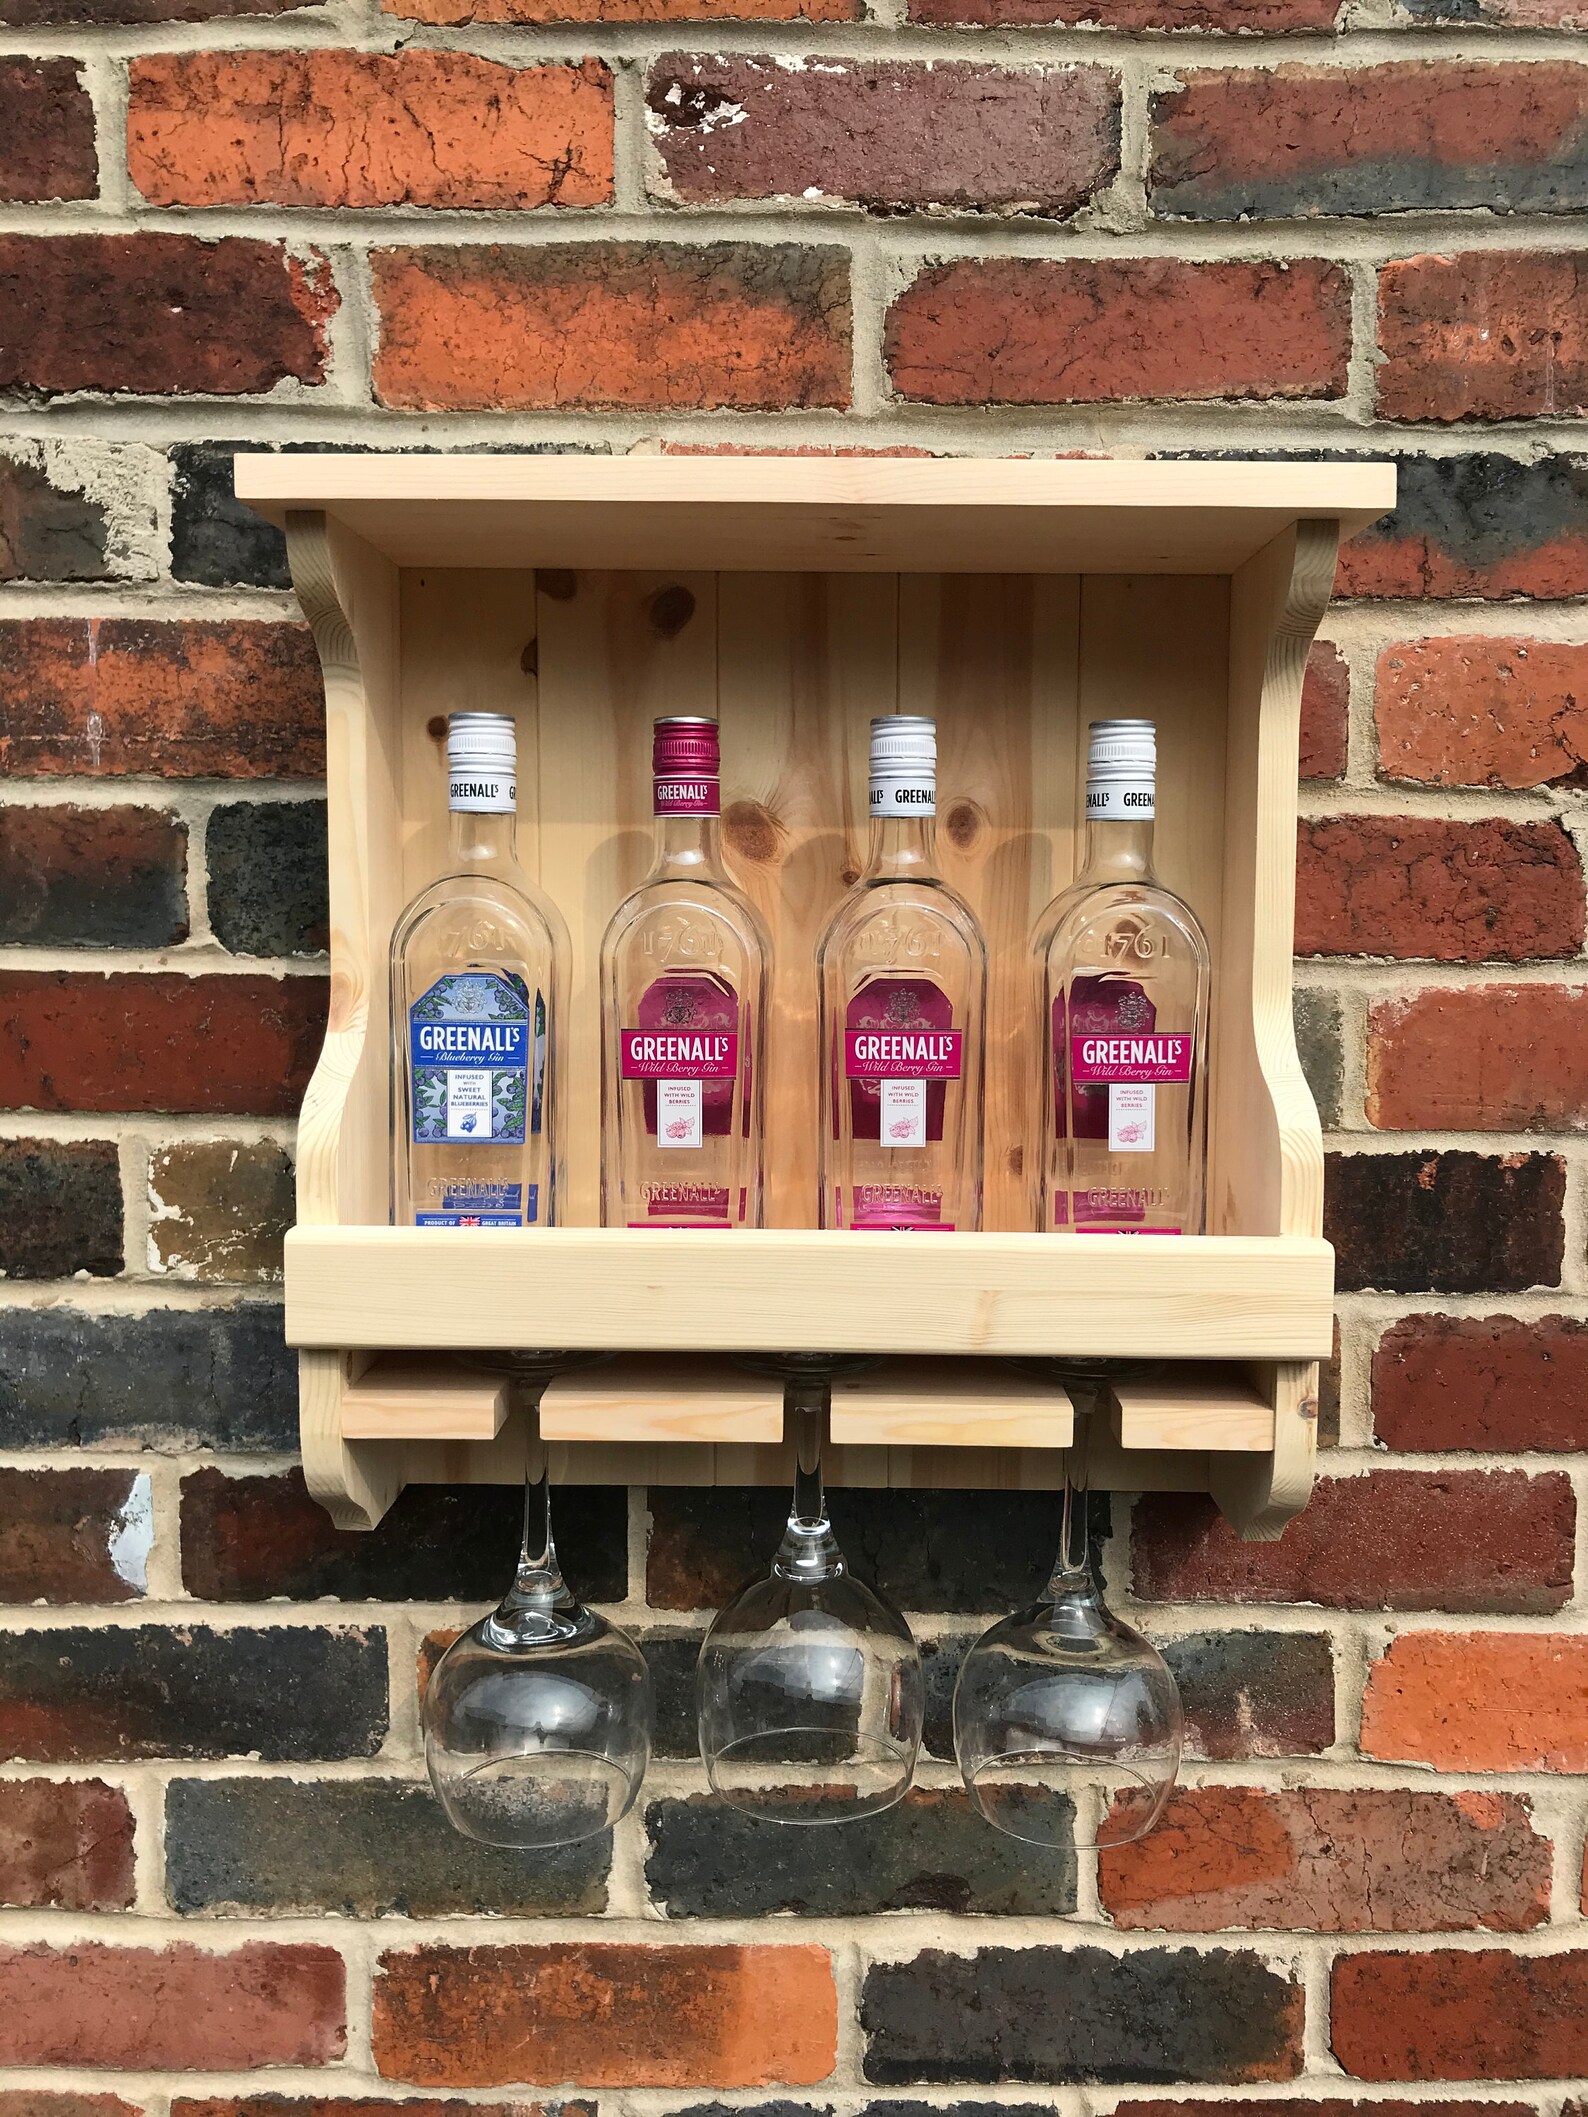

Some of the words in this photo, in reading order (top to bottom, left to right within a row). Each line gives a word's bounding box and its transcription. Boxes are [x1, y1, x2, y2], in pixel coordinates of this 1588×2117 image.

[450, 783, 499, 798] GREENALL'S
[657, 784, 708, 800] GREENALL'S
[420, 1025, 520, 1051] GREENALL'S
[630, 1036, 729, 1061] GREENALL'S
[854, 1035, 953, 1060] GREENALL'S
[1082, 1040, 1183, 1064] GREENALL'S
[435, 1051, 485, 1064] Blueberry
[487, 1052, 504, 1062] Gin
[638, 1061, 665, 1072] Wild
[666, 1061, 700, 1076] Berry
[701, 1061, 719, 1072] Gin
[862, 1060, 889, 1072] Wild
[890, 1061, 925, 1075] Berry
[925, 1061, 944, 1072] Gin
[1090, 1065, 1118, 1076] Wild
[1118, 1065, 1153, 1080] Berry
[1154, 1065, 1173, 1076] Gin
